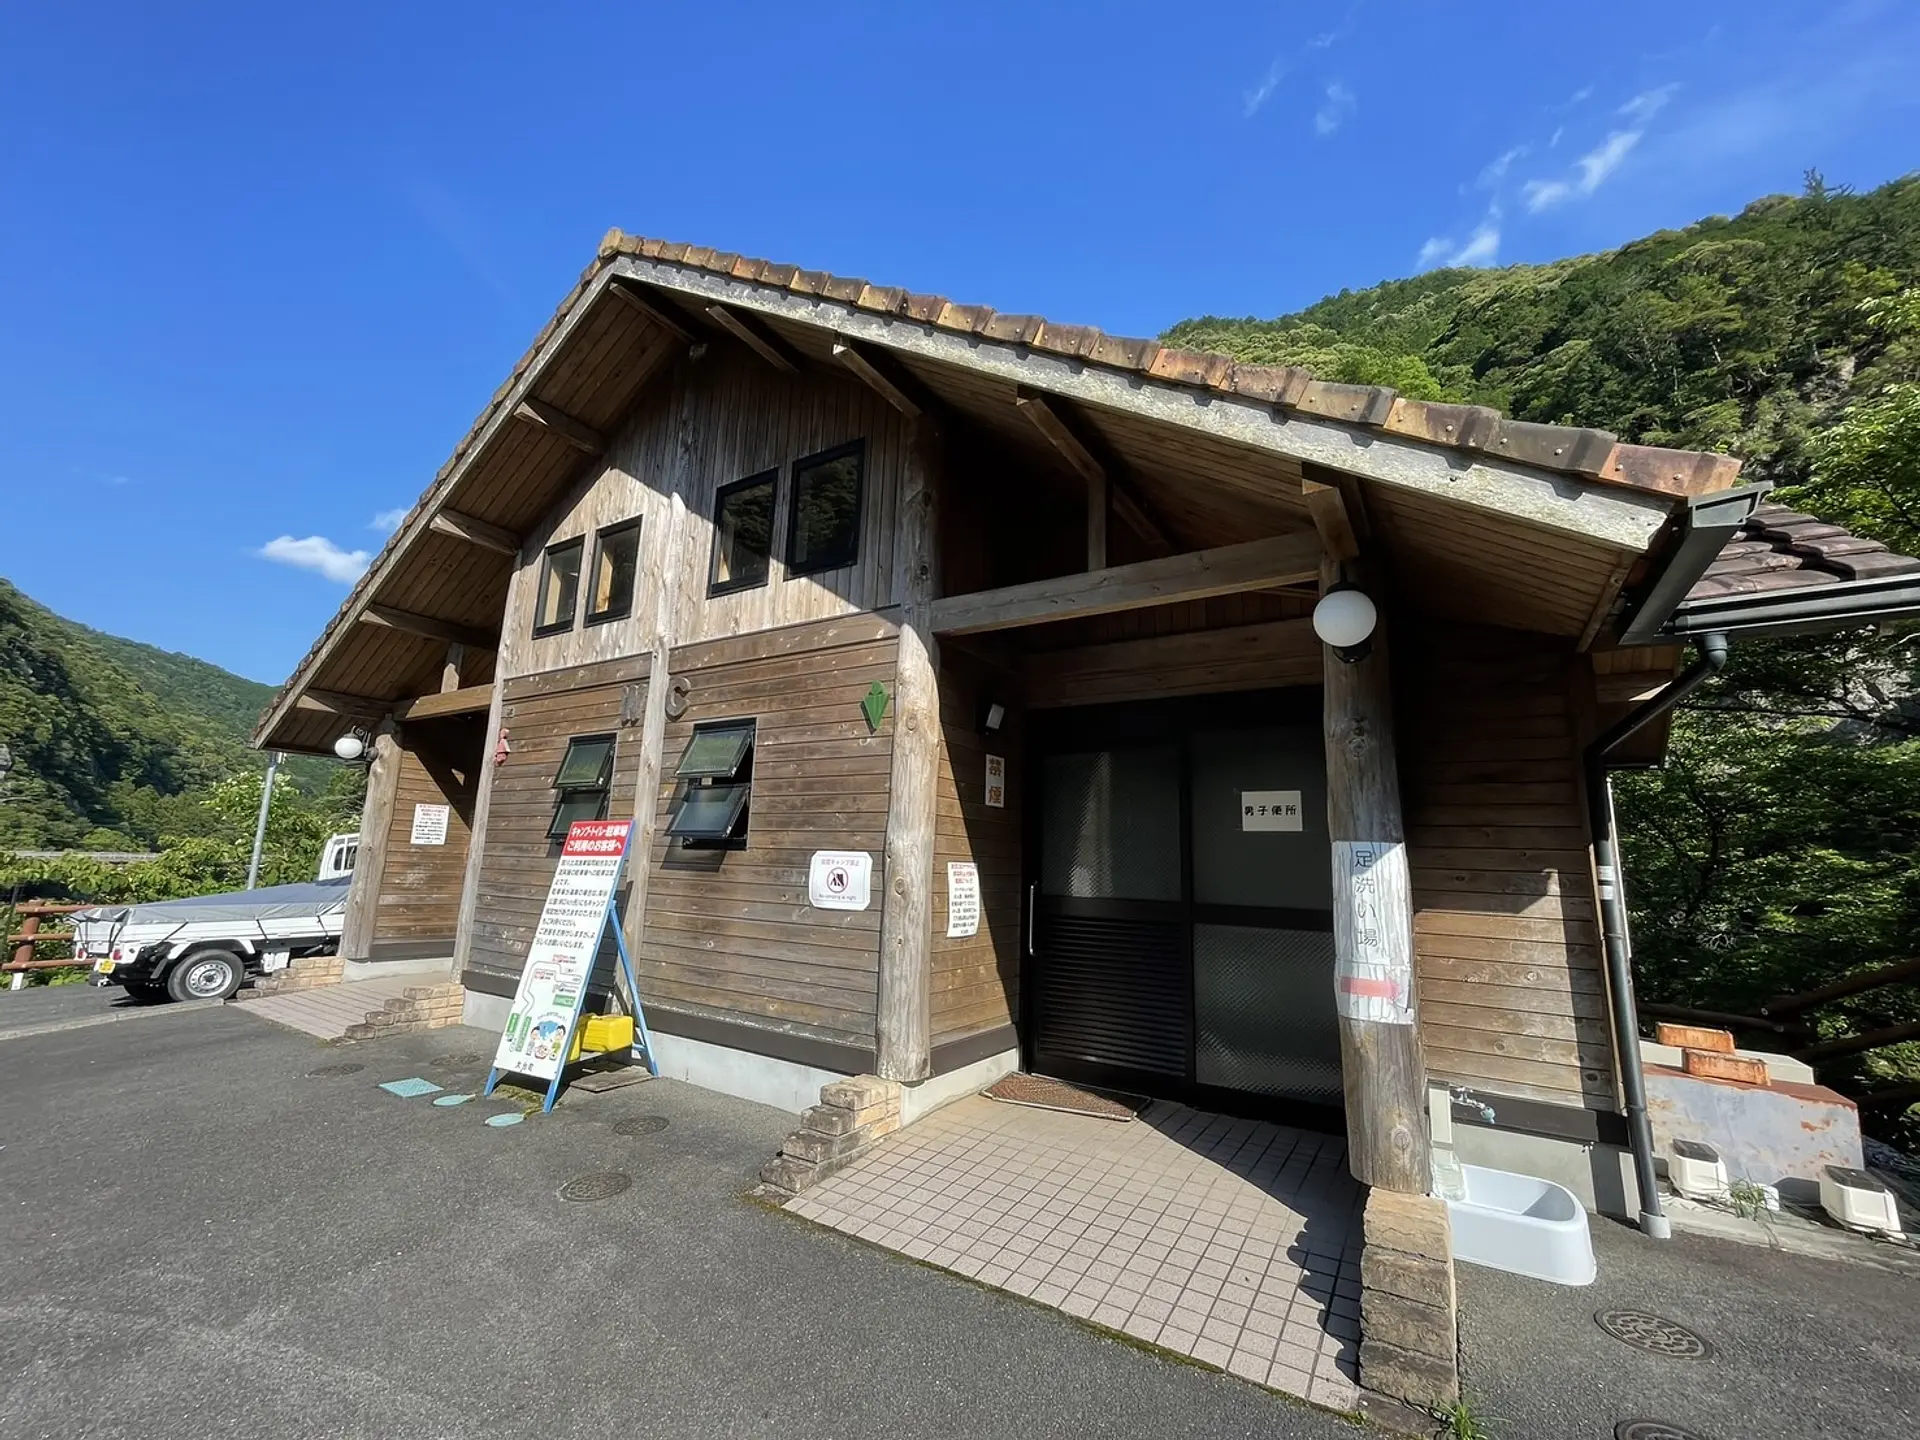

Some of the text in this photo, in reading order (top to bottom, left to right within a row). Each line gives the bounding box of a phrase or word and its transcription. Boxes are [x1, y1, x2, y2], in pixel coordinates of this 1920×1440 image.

[988, 757, 1002, 804] 禁煙
[1244, 804, 1297, 816] 男子便所
[1354, 850, 1378, 948] 足洗い場
